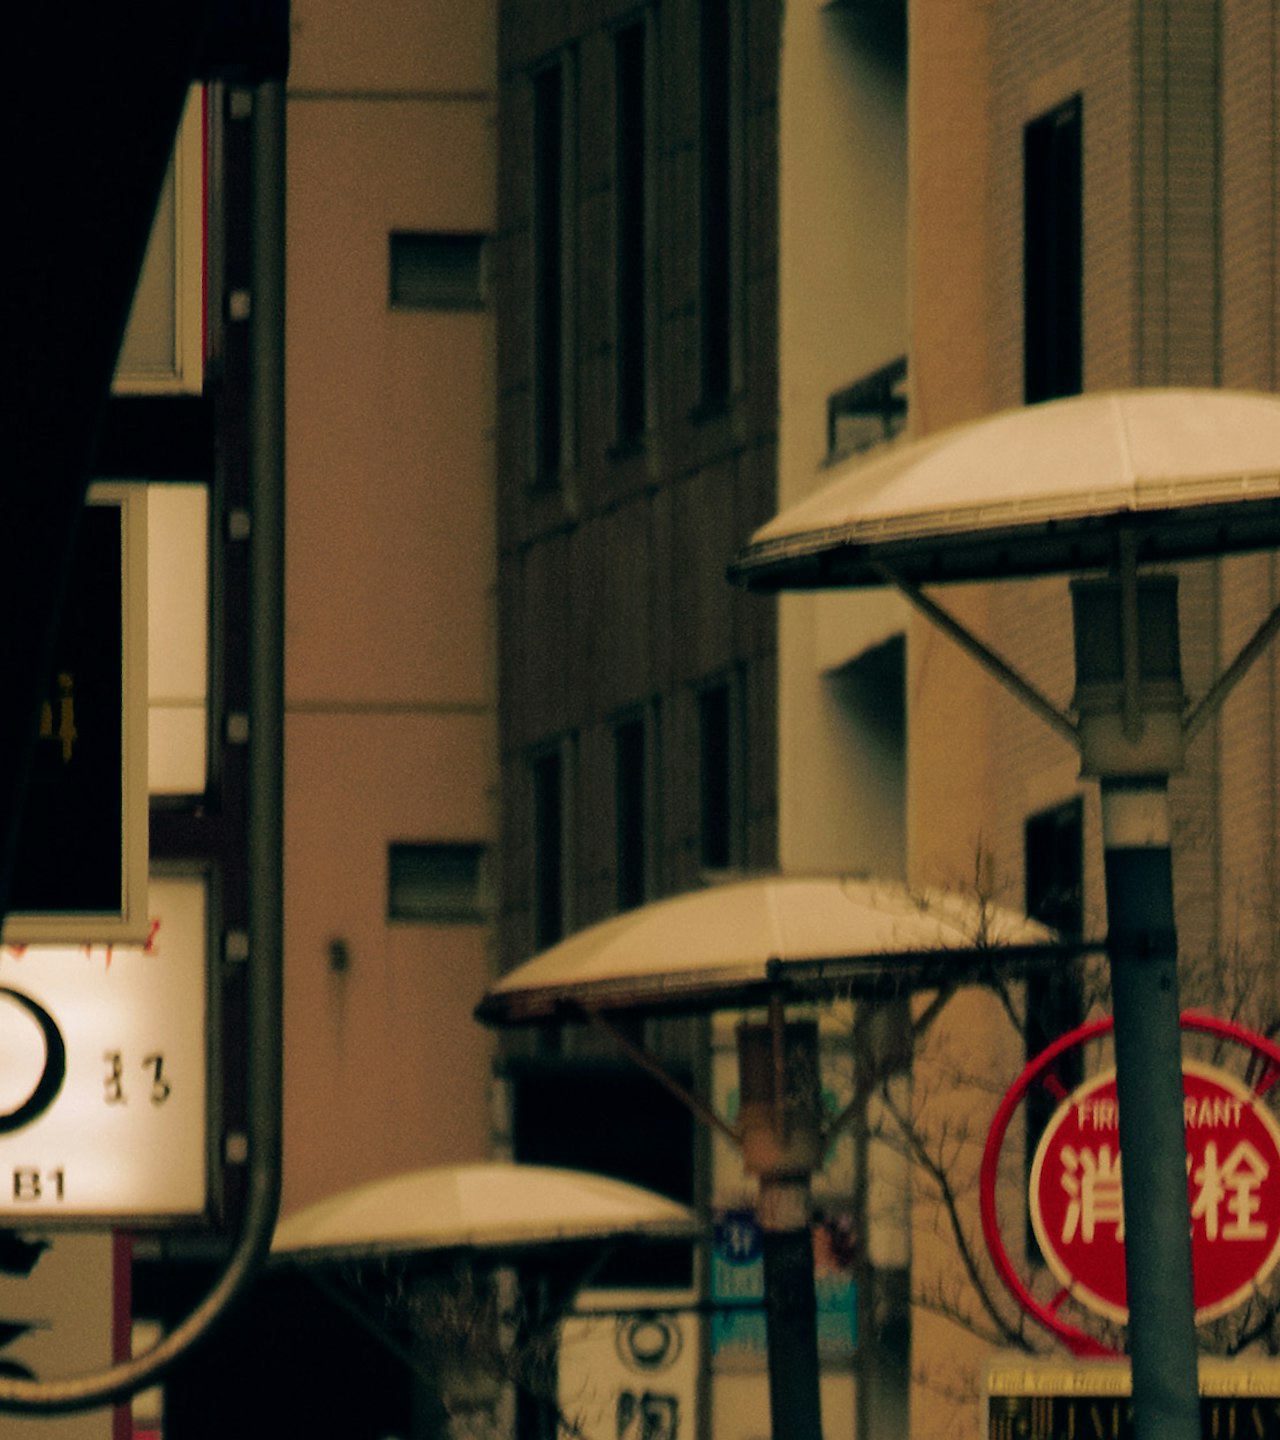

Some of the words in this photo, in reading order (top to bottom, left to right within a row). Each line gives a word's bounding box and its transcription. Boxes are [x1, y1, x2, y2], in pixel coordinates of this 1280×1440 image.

[1077, 1096, 1119, 1132] FIR
[1184, 1096, 1243, 1129] RANT
[13, 1165, 65, 1202] B1
[1058, 1141, 1271, 1245] 消栓
